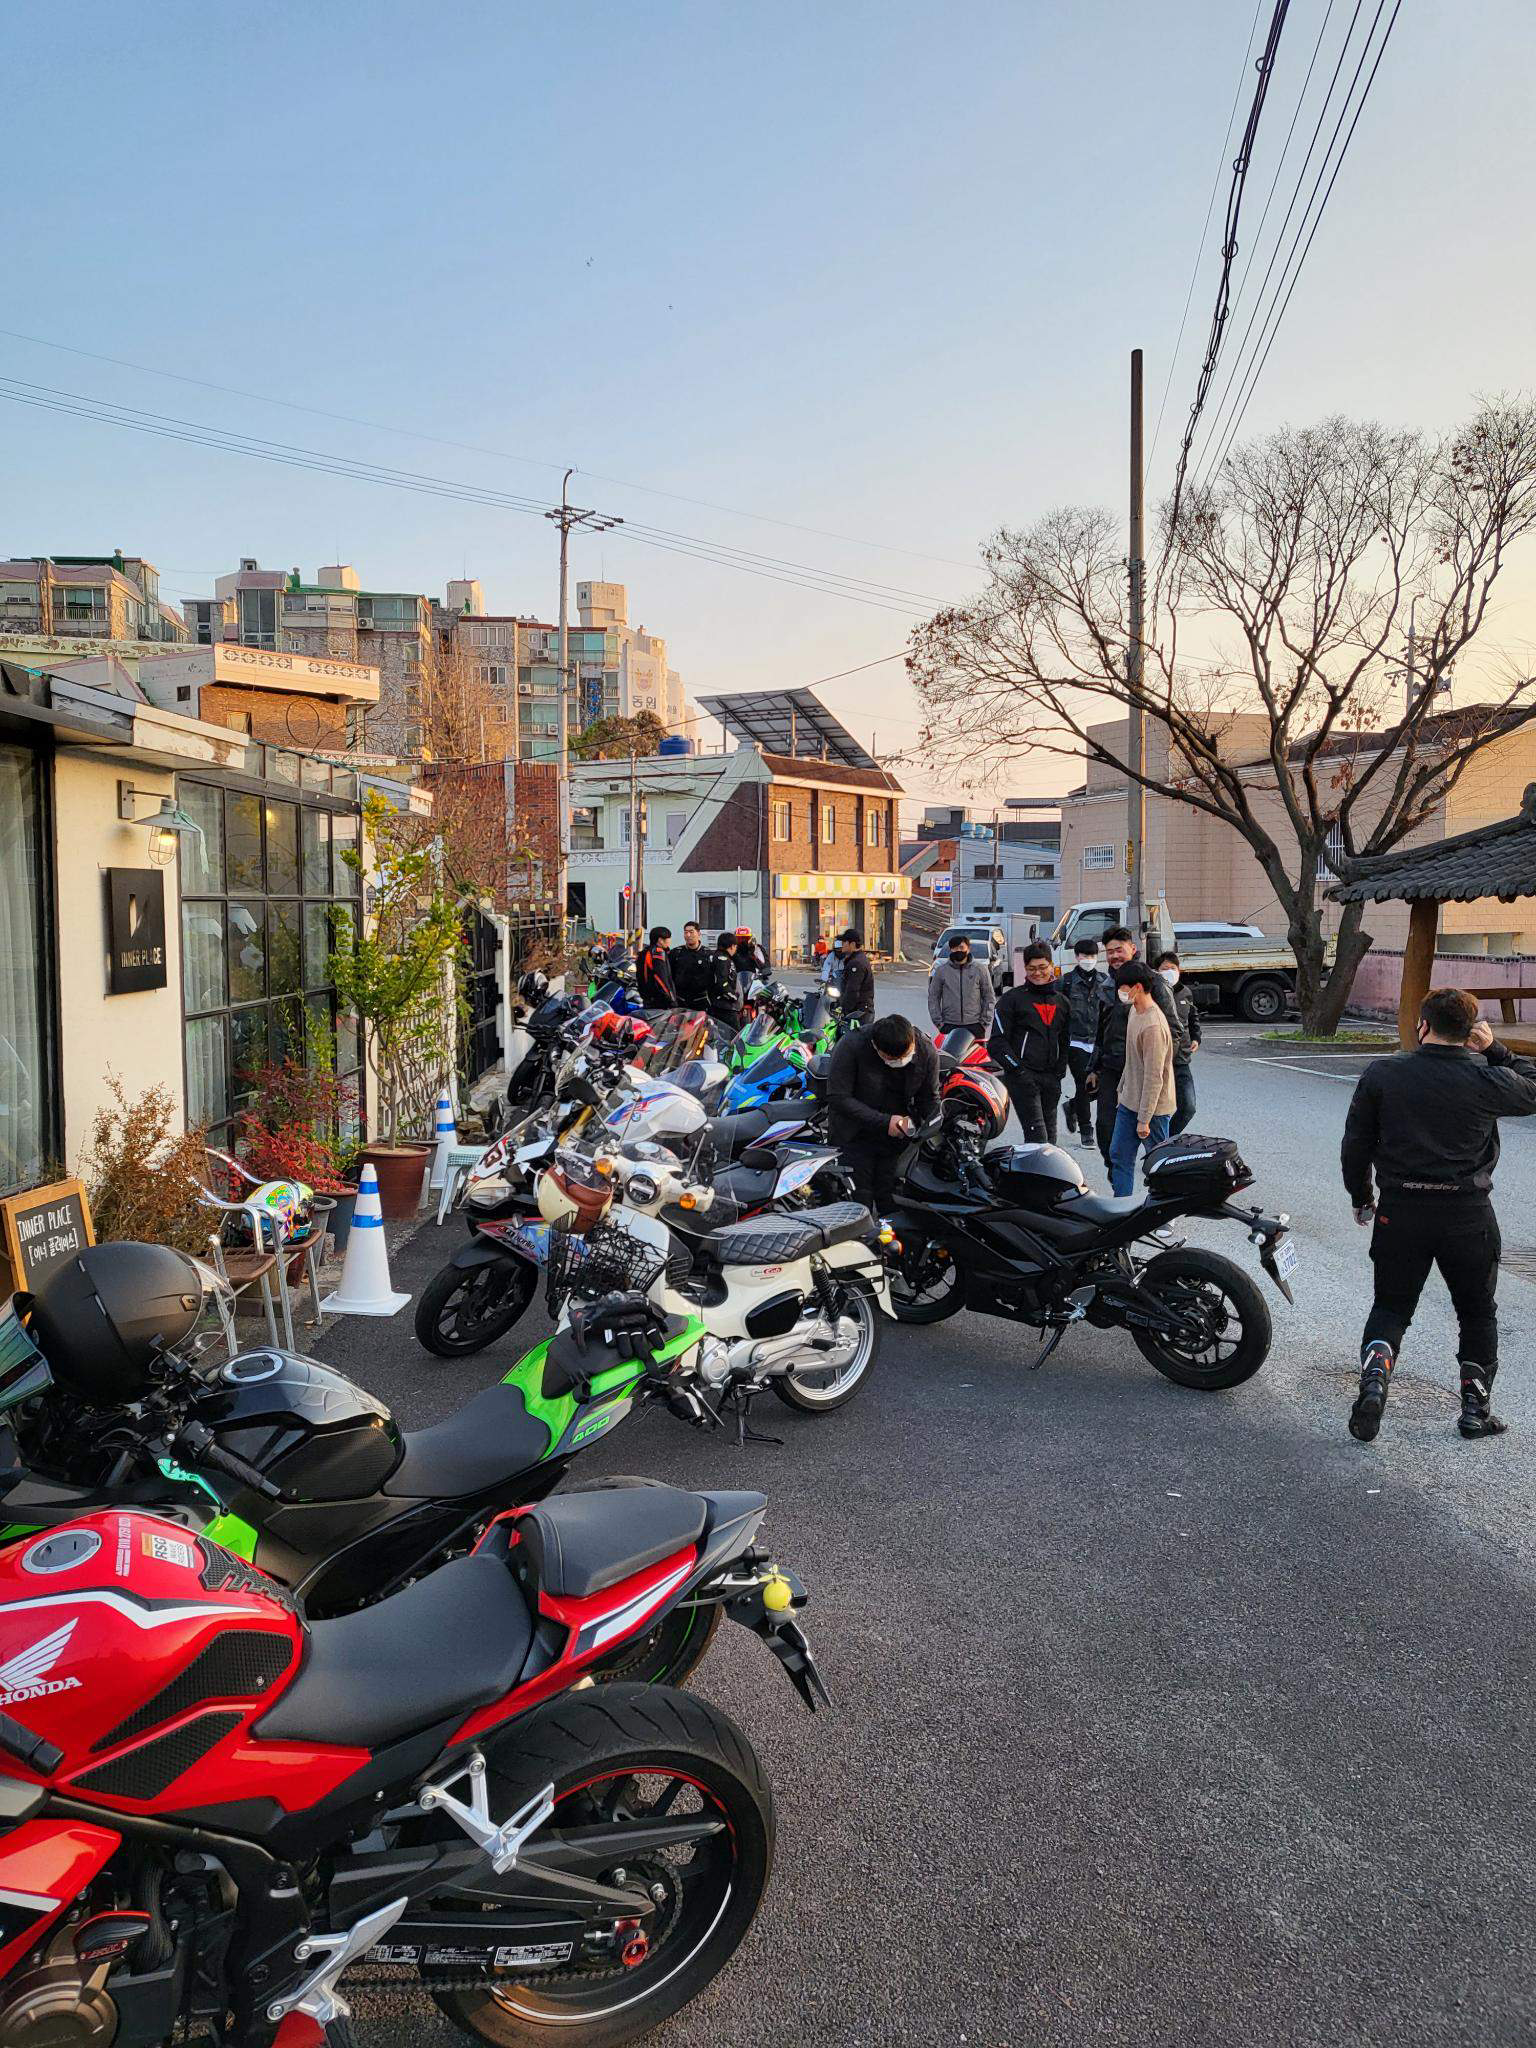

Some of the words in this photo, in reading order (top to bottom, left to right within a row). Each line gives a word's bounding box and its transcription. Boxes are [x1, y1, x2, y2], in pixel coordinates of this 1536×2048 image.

[632, 695, 657, 710] 동원
[141, 947, 162, 966] PLCE
[17, 1214, 45, 1242] INNER
[47, 1205, 72, 1231] PLACE
[572, 1415, 610, 1445] 400
[154, 1537, 168, 1560] RSG
[0, 1676, 83, 1706] HONDA
